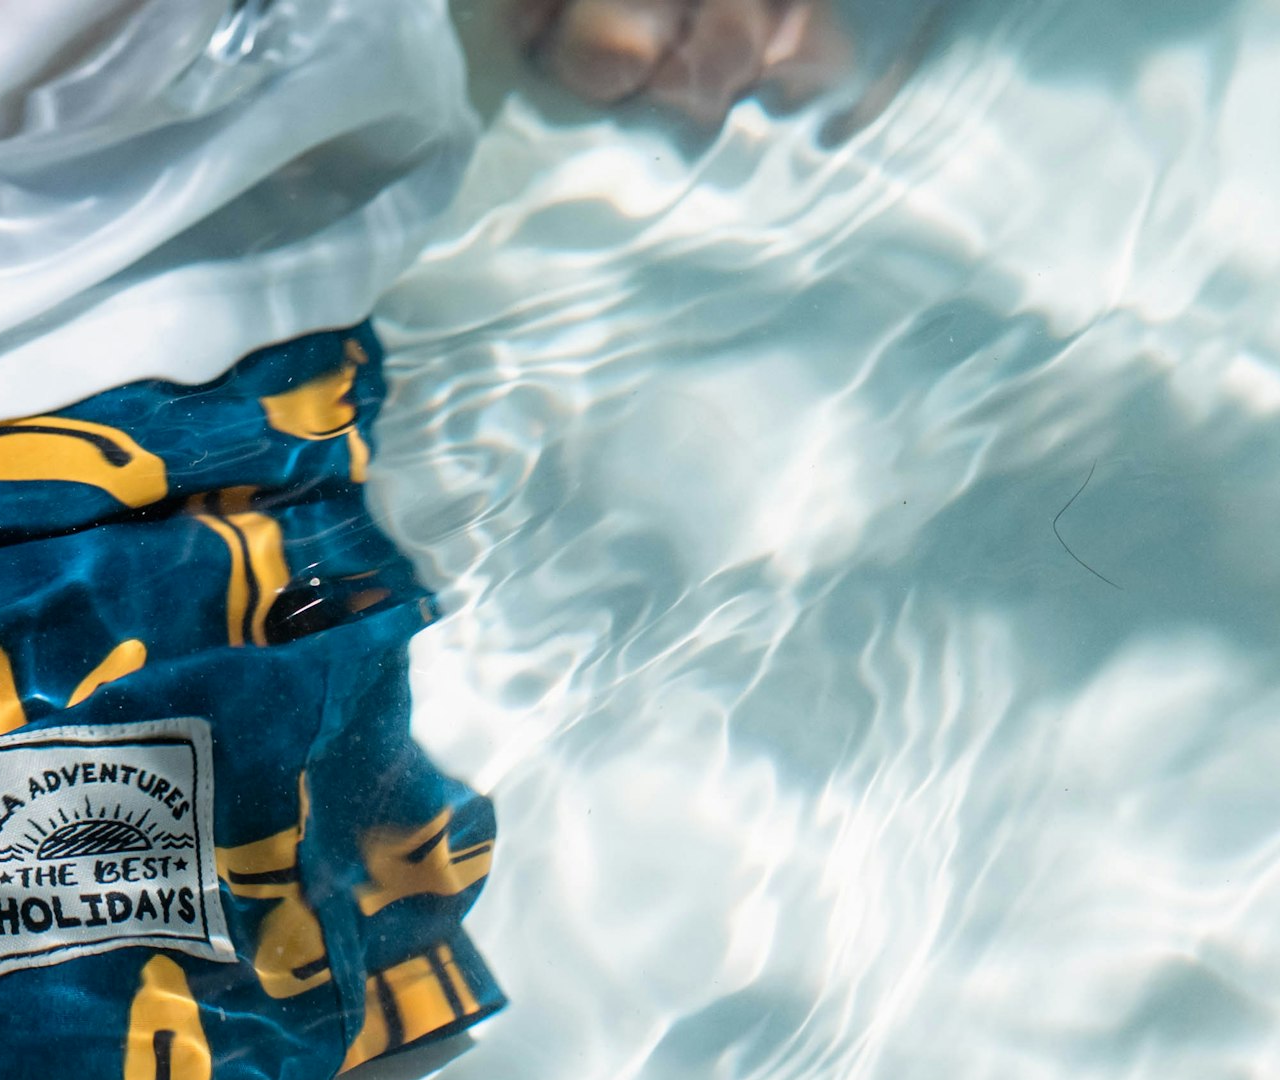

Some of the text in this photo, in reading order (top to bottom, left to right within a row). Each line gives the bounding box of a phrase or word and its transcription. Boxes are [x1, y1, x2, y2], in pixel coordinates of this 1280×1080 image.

[28, 762, 190, 820] ADVENTURES
[16, 856, 172, 888] THE BEST
